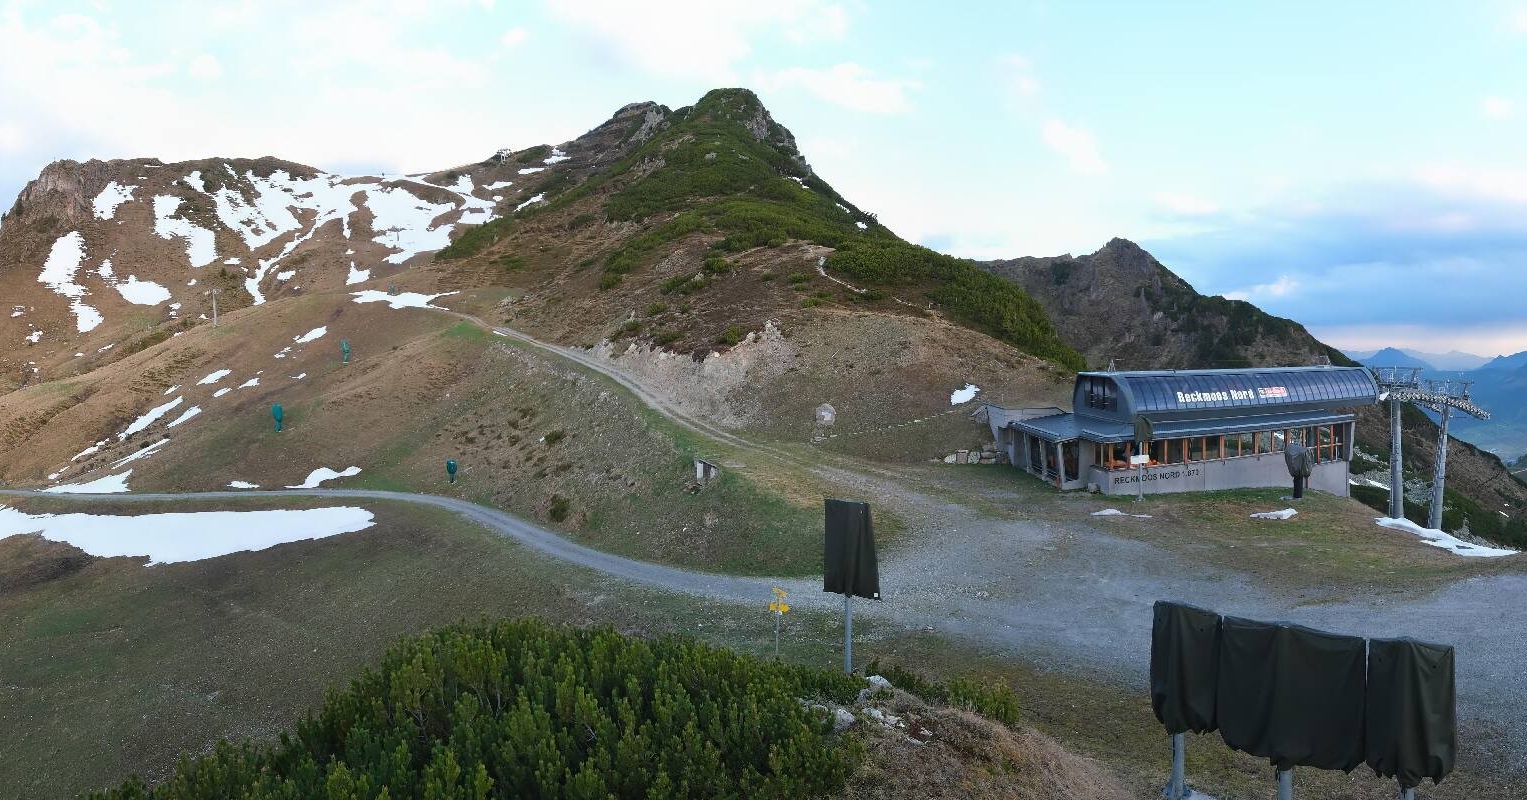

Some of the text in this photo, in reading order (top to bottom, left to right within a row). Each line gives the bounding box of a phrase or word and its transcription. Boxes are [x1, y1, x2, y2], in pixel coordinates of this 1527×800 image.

[1177, 390, 1228, 402] Reckmoos
[1230, 388, 1254, 400] Nord
[1159, 471, 1180, 480] NORD
